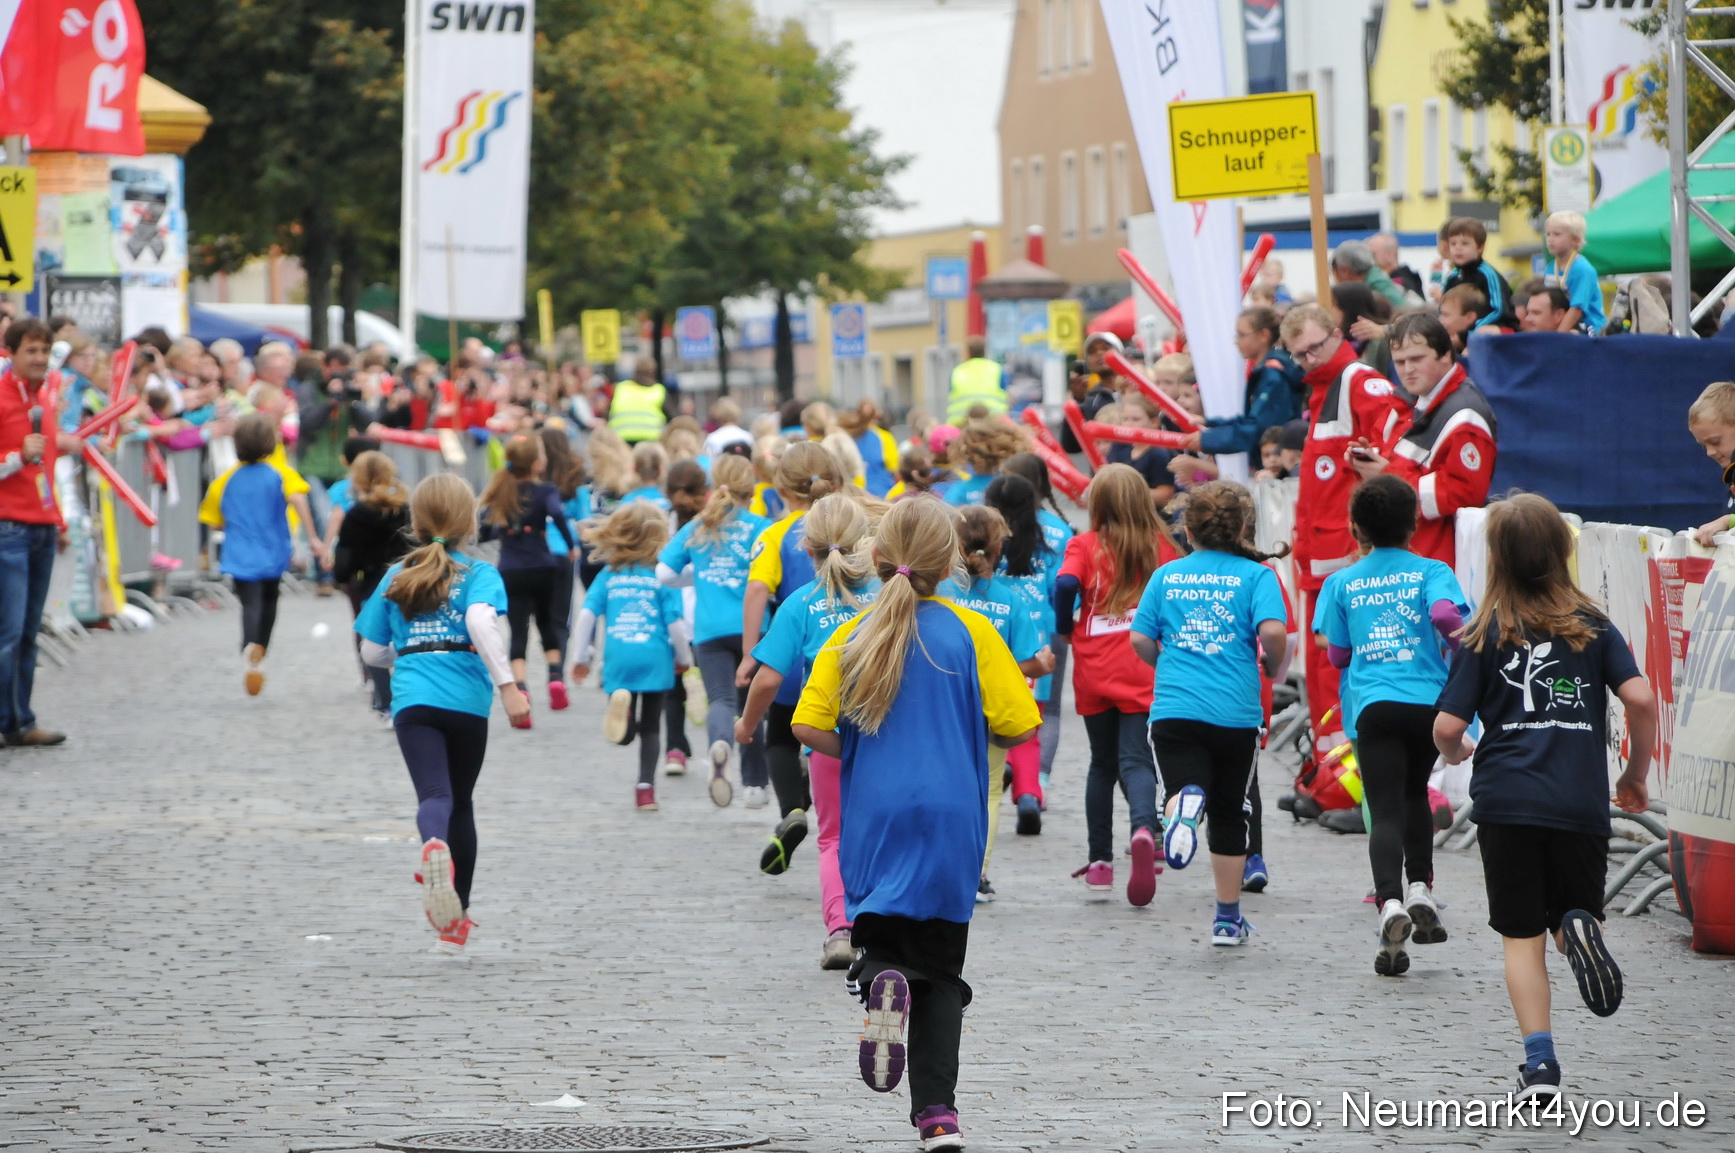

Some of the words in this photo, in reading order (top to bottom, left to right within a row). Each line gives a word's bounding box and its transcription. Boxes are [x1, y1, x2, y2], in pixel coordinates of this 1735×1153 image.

[431, 2, 525, 32] swn
[1179, 125, 1306, 149] Schnupper-
[1224, 151, 1264, 172] lauf
[1162, 573, 1242, 587] NEUMARKTER
[1345, 571, 1424, 594] NEUMARKTER
[1165, 589, 1235, 602] STADTLAUF
[1351, 587, 1420, 609] STADTLAUF
[1211, 601, 1235, 623] 2014
[1396, 601, 1421, 624] 2014
[1356, 639, 1401, 655] BAMBINI
